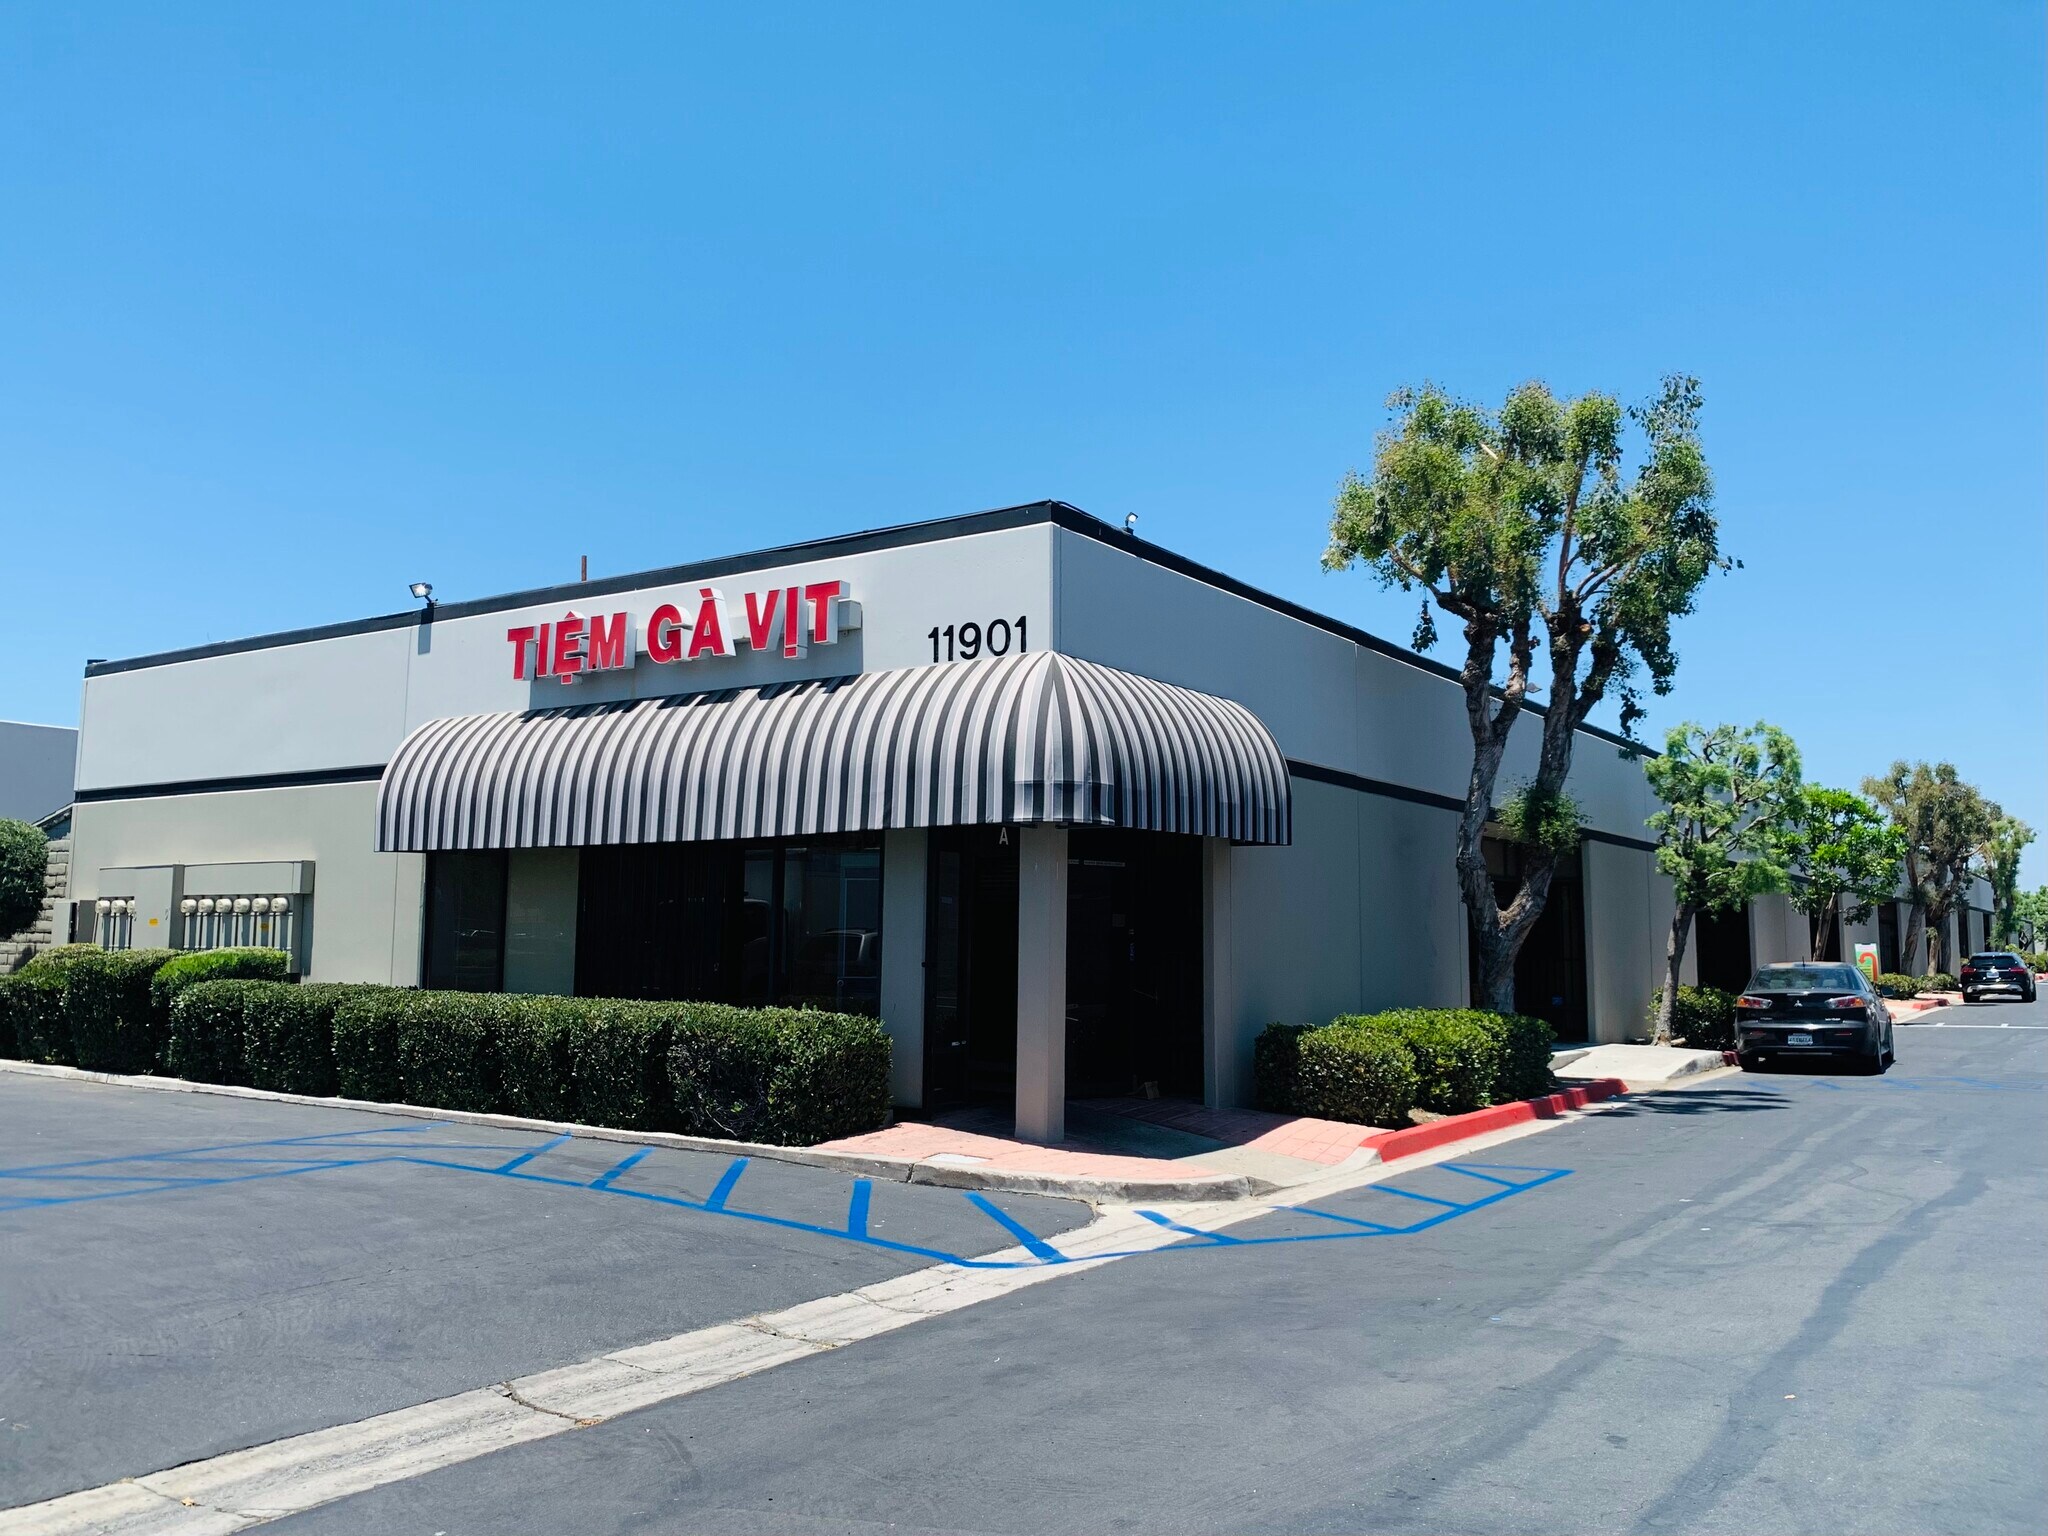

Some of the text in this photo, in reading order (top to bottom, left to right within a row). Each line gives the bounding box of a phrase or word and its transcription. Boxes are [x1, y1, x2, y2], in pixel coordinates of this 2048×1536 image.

[507, 580, 842, 685] TIỆM GÀ VỊT
[928, 615, 1027, 663] 11901
[999, 826, 1009, 845] A
